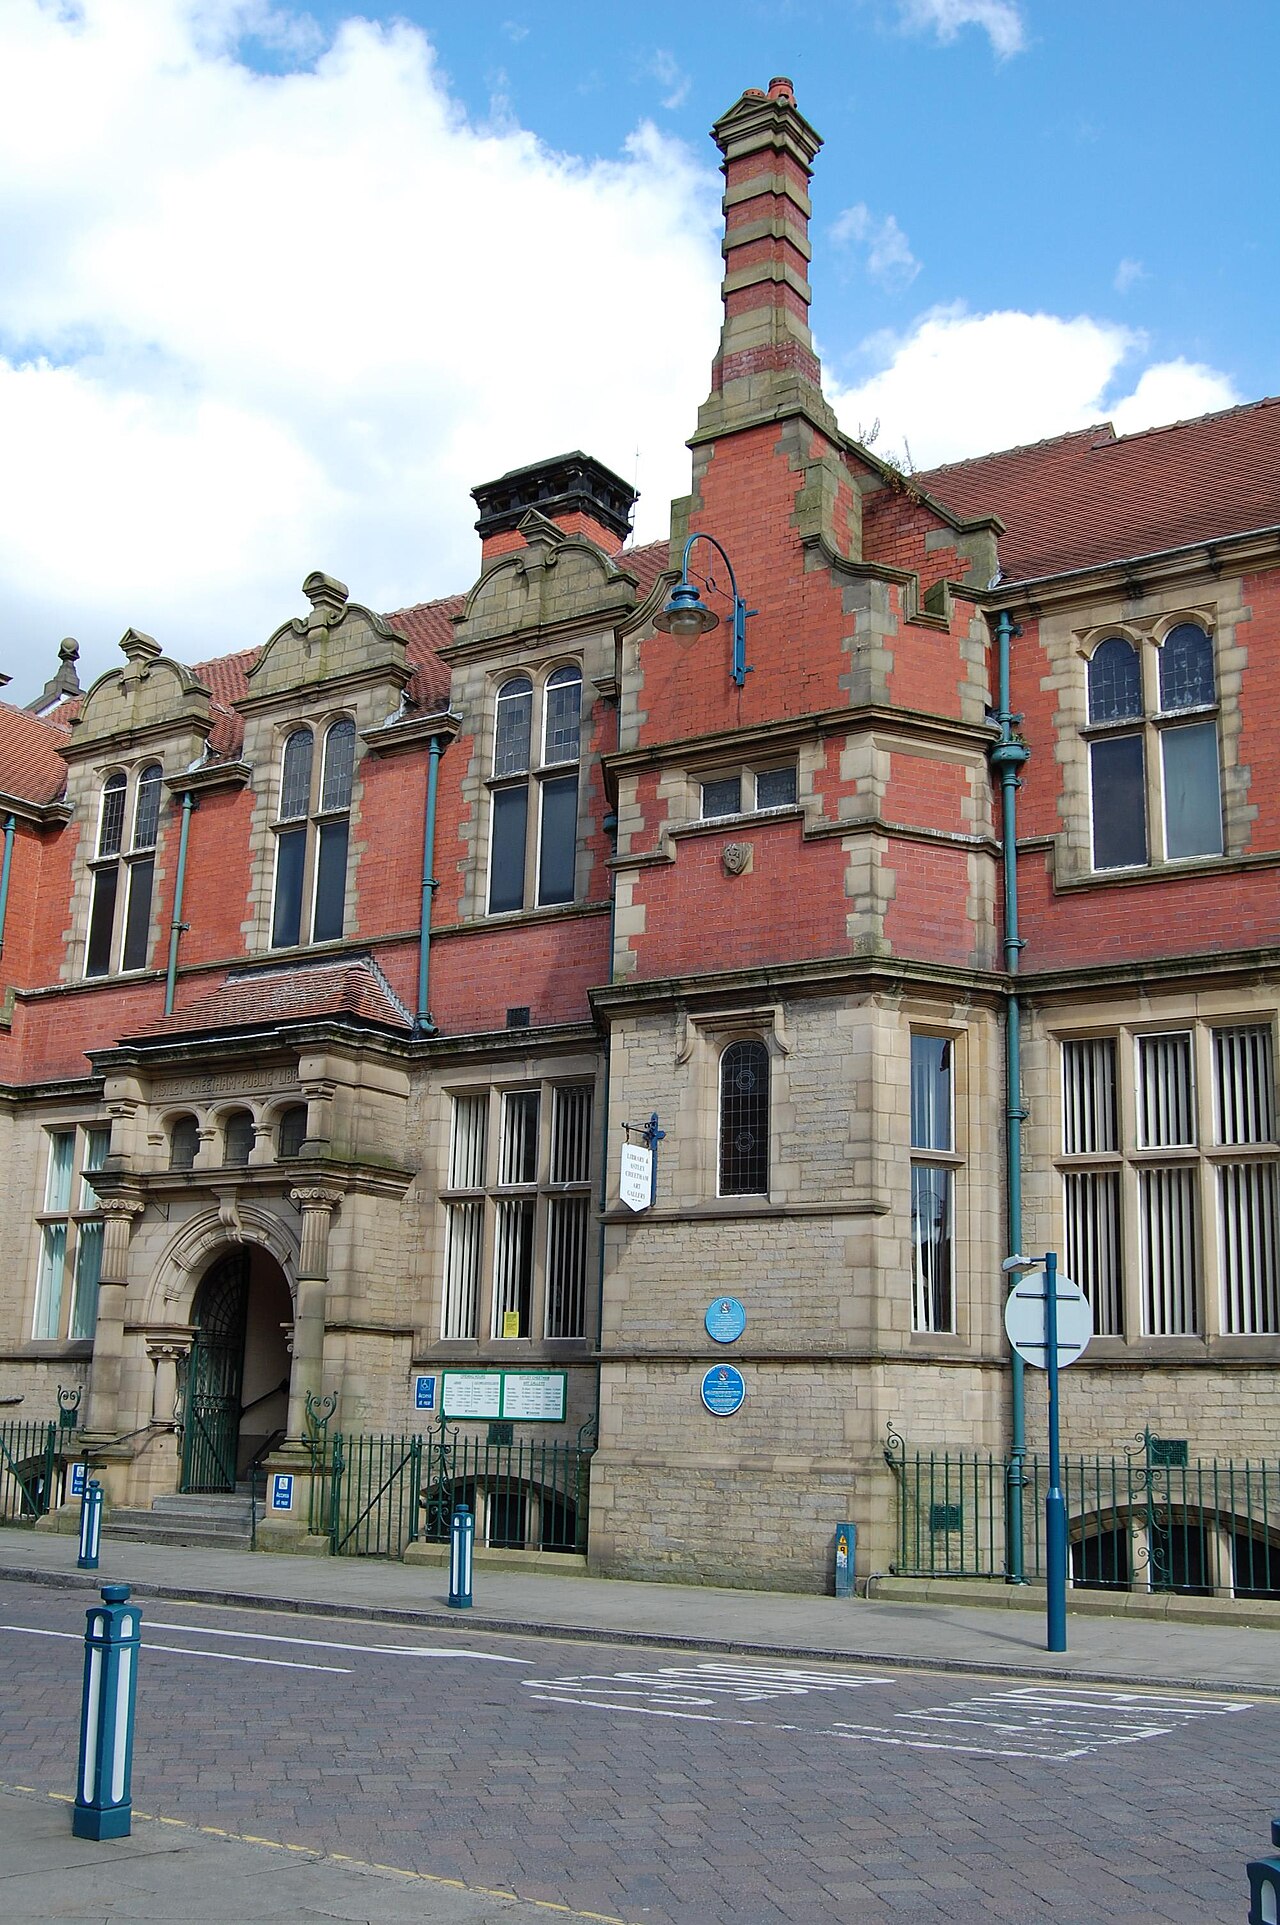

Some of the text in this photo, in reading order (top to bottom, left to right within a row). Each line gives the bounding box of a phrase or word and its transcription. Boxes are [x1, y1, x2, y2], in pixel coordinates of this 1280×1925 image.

[153, 1081, 185, 1098] ASTLEY
[189, 1076, 237, 1094] CHEETHAM
[241, 1071, 273, 1089] PUBLIC
[521, 1663, 897, 1705] BUSES
